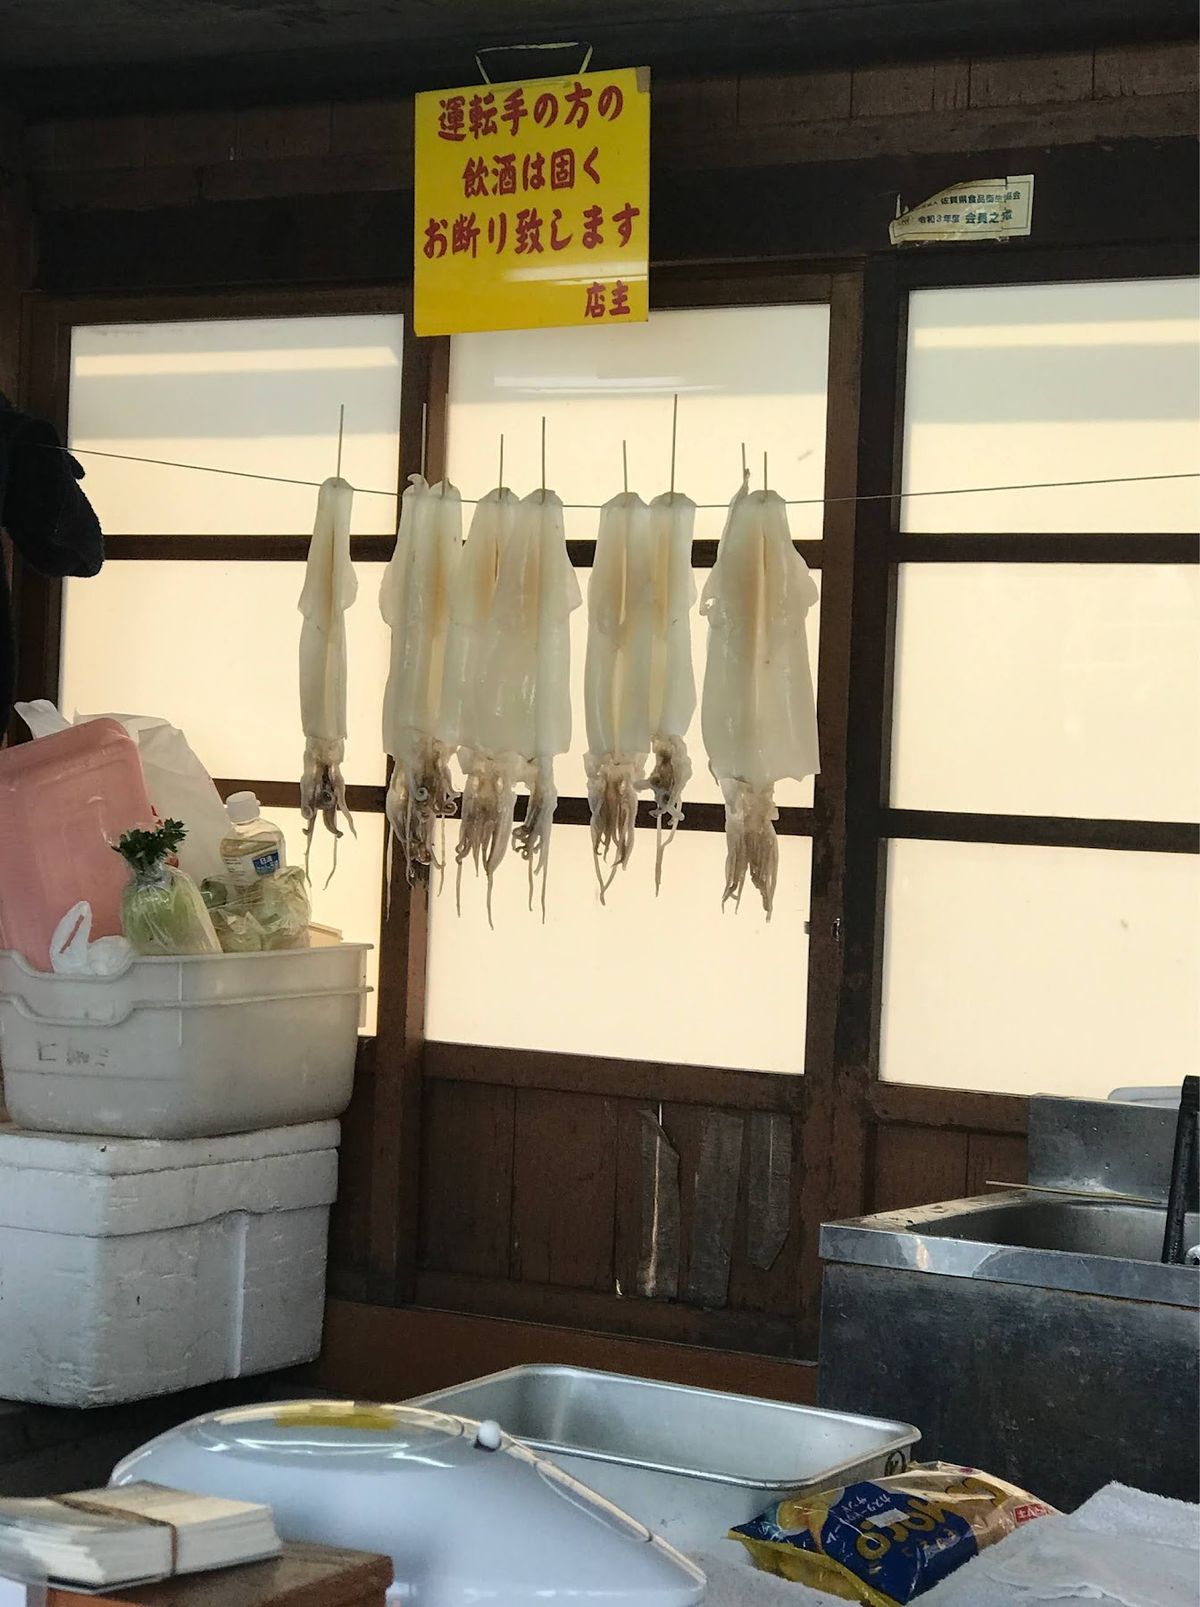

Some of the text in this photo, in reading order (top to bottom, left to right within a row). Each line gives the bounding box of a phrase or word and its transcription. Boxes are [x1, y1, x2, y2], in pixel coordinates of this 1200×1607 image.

[437, 81, 624, 142] 運転手の方の
[462, 146, 600, 198] 飲酒は固く
[423, 202, 640, 259] お断り致します
[585, 279, 631, 318] 店主
